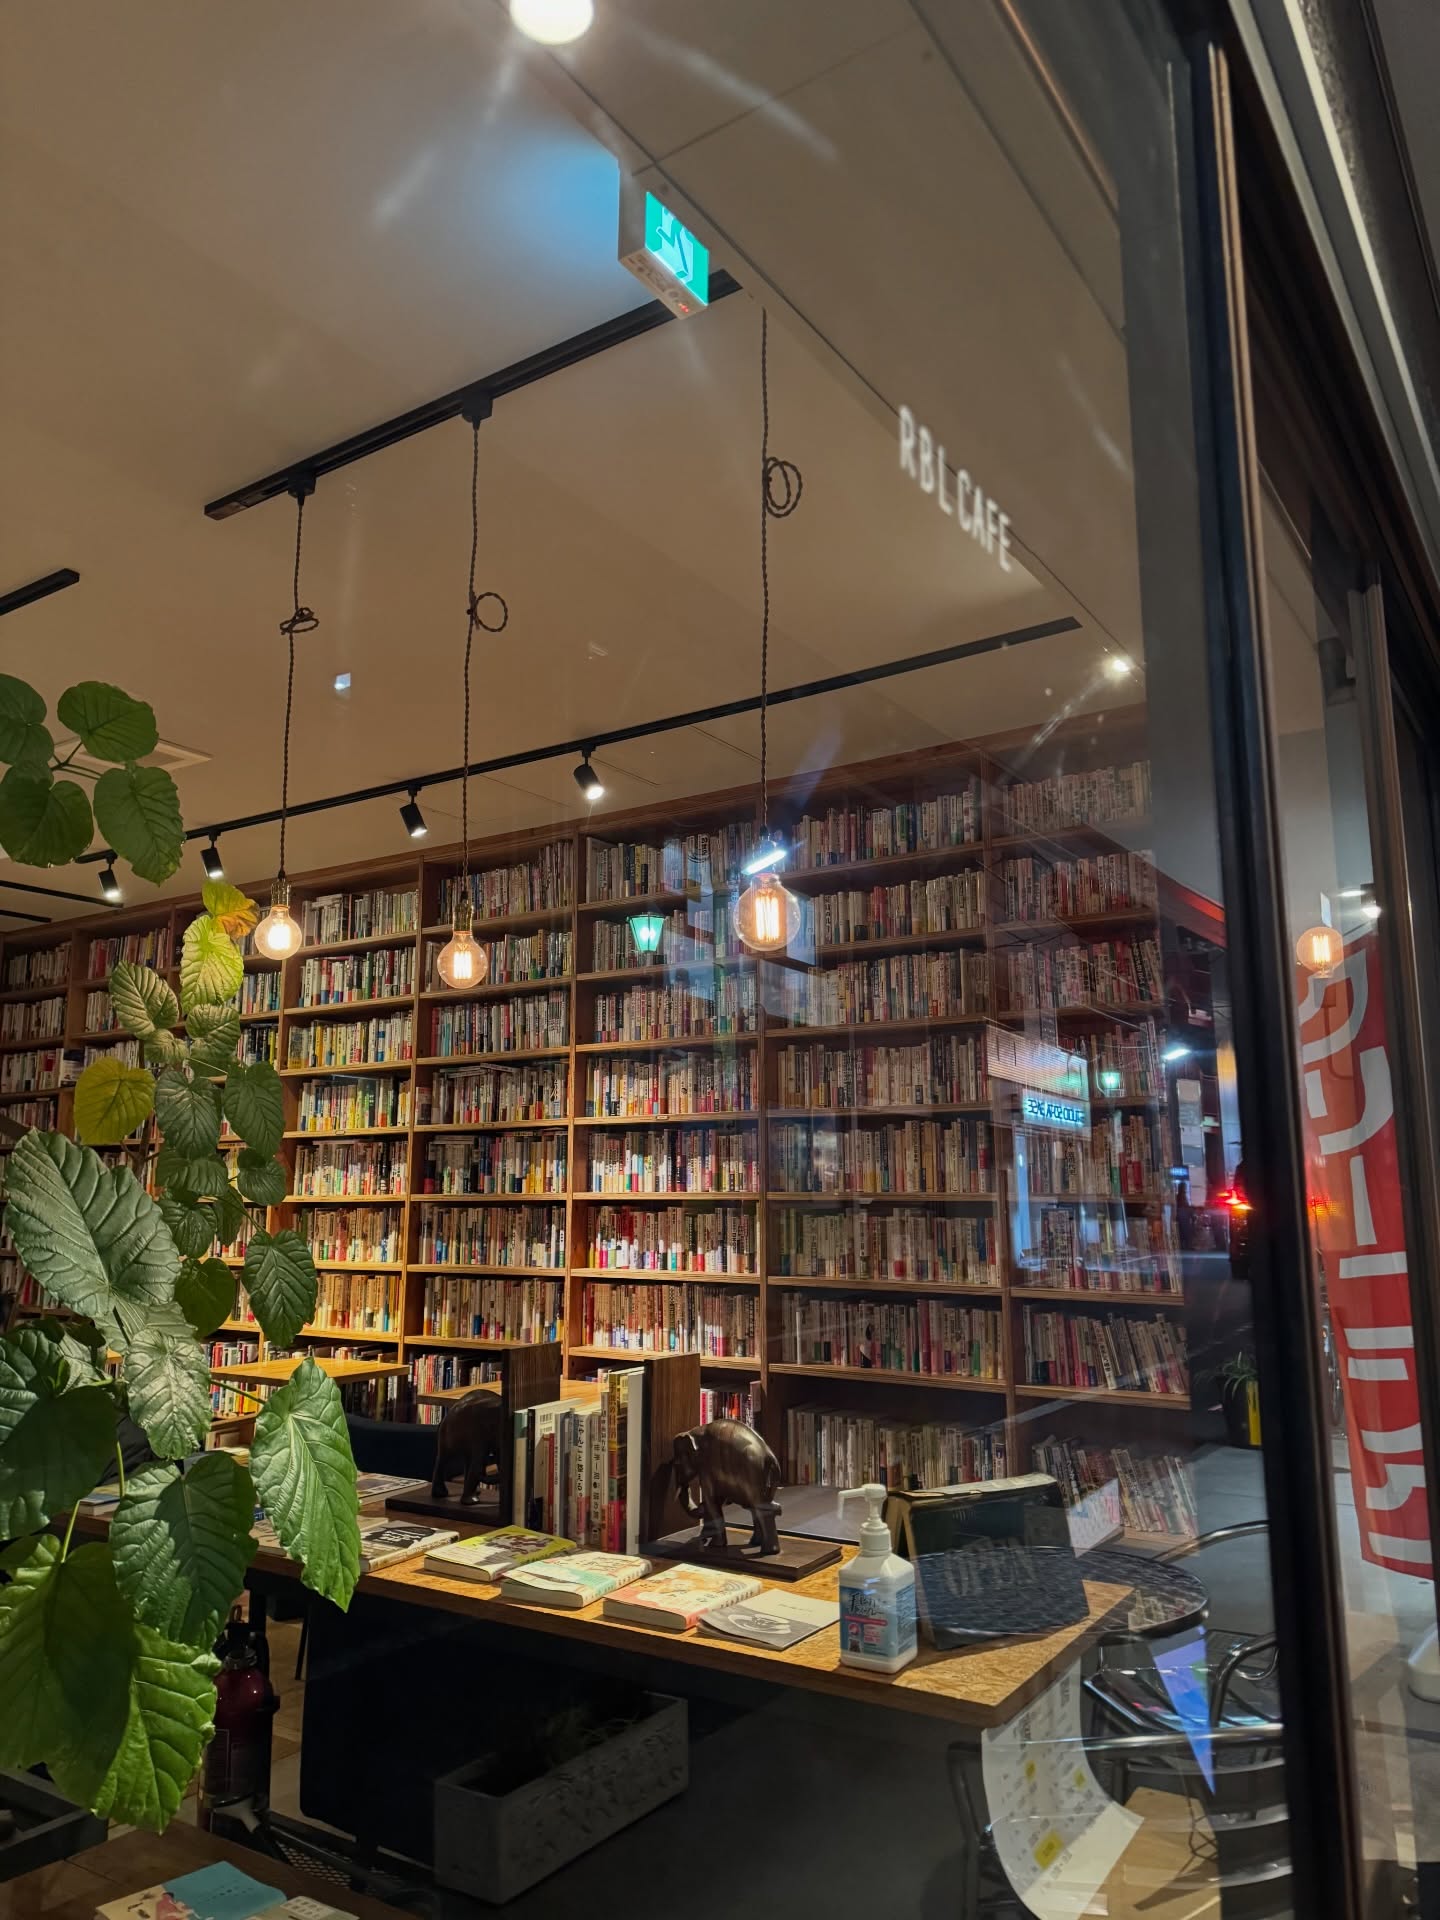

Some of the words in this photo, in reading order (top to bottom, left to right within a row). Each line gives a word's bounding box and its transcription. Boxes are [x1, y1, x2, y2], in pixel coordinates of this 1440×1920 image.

[900, 405, 953, 516] RBL
[957, 469, 1011, 572] CAFE
[944, 1538, 1038, 1597] OPEN
